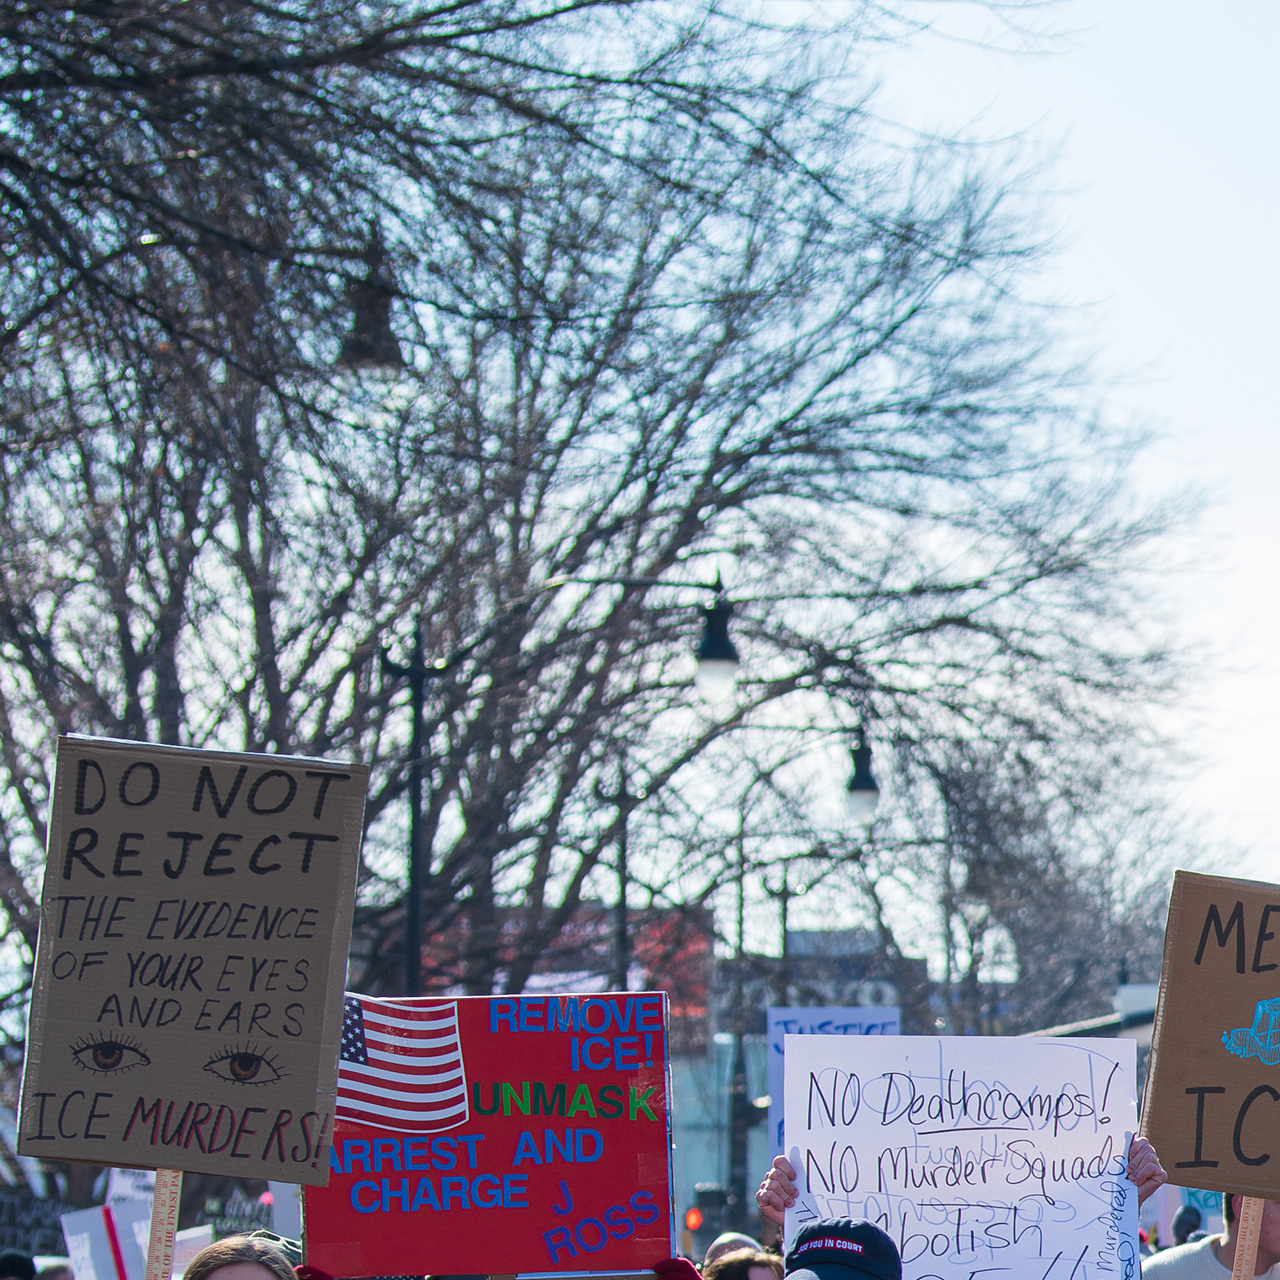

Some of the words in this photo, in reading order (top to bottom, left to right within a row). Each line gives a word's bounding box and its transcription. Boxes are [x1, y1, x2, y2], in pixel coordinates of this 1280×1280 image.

[73, 758, 161, 818] DO
[192, 764, 352, 820] NOT
[62, 827, 341, 881] REJECT
[51, 895, 136, 942] THE
[146, 899, 320, 941] EVIDENCE
[51, 951, 110, 982] OF
[126, 952, 205, 993] YOUR
[216, 954, 311, 993] EYES
[96, 993, 183, 1029] AND
[194, 998, 306, 1039] EARS
[489, 996, 663, 1033] REMOVE
[570, 1033, 654, 1072] ICE!
[472, 1081, 659, 1122] UNMASK
[806, 1069, 861, 1131] NO
[26, 1089, 114, 1142] ICE
[122, 1096, 333, 1170] MURDERS!
[511, 1128, 605, 1167] AND
[806, 1140, 860, 1195] NO
[878, 1143, 1004, 1193] Murder
[166, 1188, 179, 1227] FINEST
[350, 1173, 529, 1215] CHARGE
[552, 1180, 576, 1217] J
[164, 1228, 174, 1250] THE
[542, 1190, 661, 1266] ROSS
[825, 1238, 835, 1248] IN
[836, 1239, 864, 1253] COURT
[876, 1205, 1043, 1264] bolish
[1096, 1180, 1132, 1272] Murdered
[162, 1251, 172, 1267] OF
